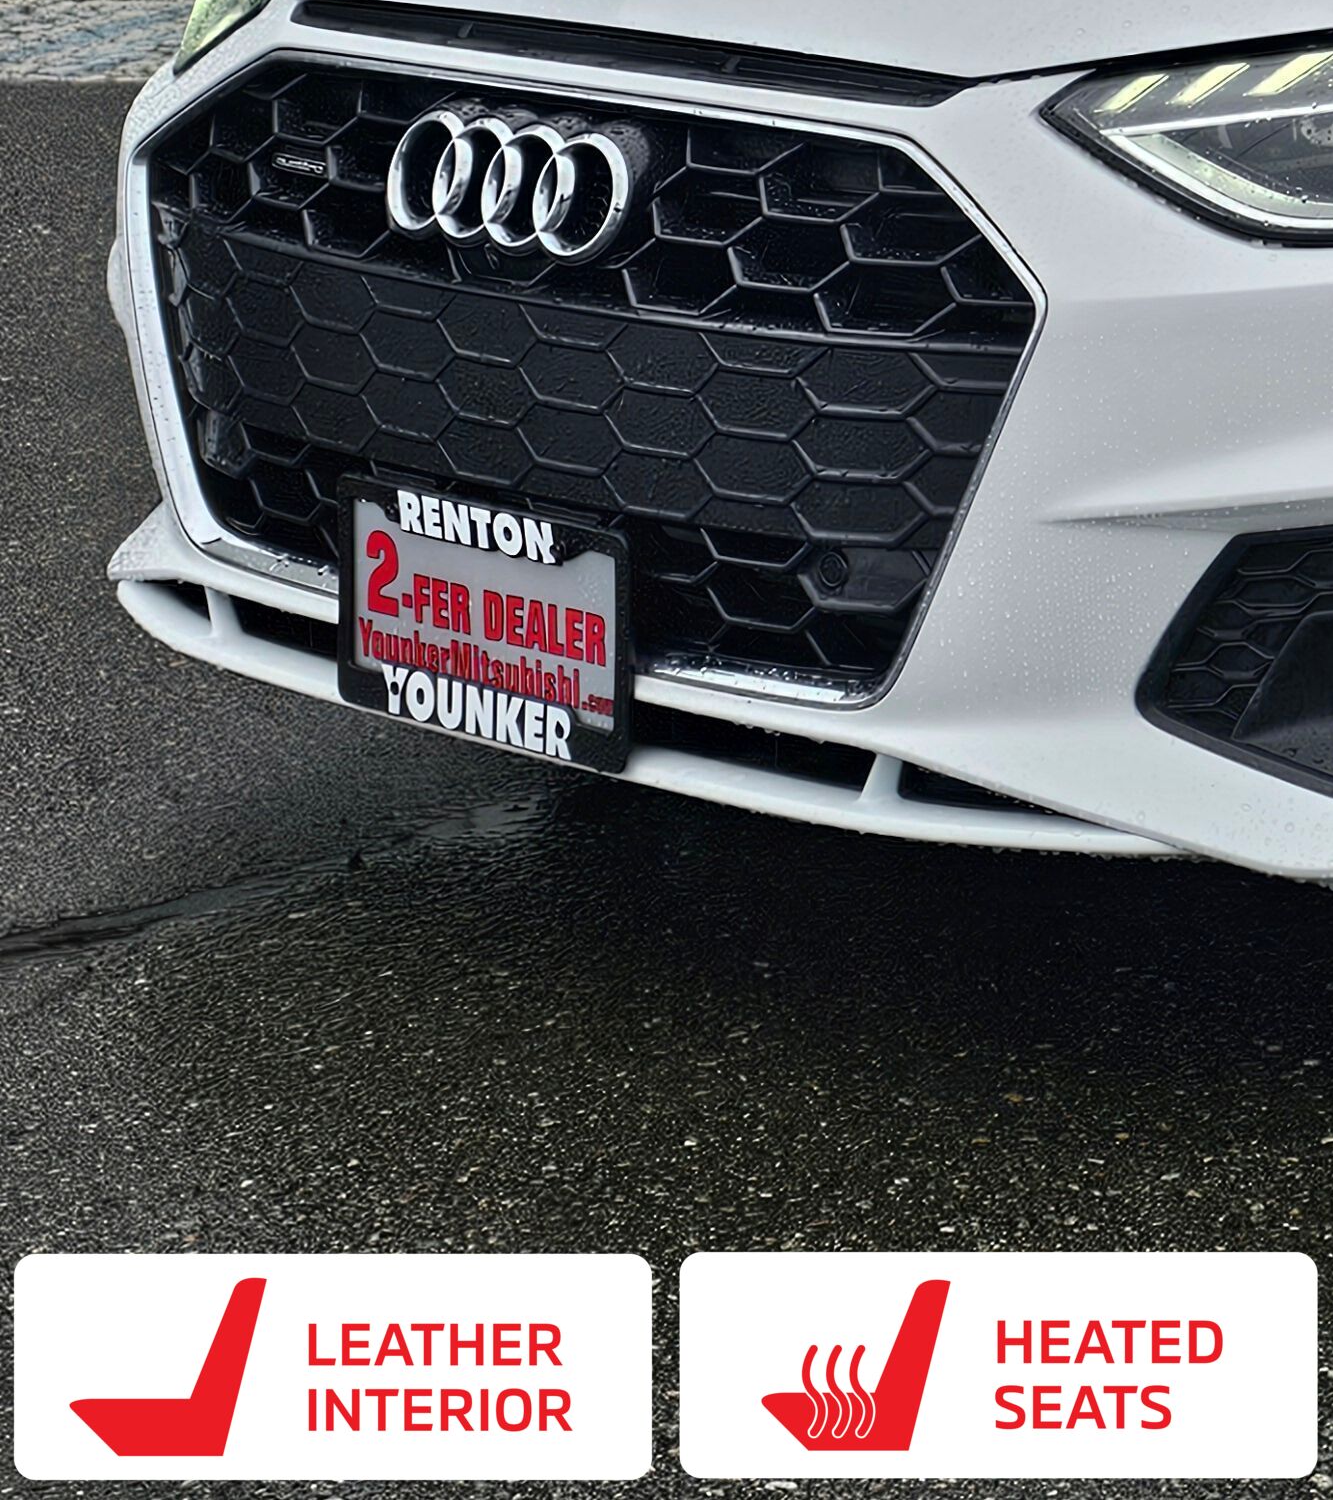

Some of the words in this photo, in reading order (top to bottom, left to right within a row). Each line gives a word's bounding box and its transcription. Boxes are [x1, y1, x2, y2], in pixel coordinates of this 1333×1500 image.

[396, 489, 557, 565] RENTON
[366, 529, 471, 636] 2-FER
[483, 589, 607, 667] DEALER
[381, 663, 572, 761] YOUNKER
